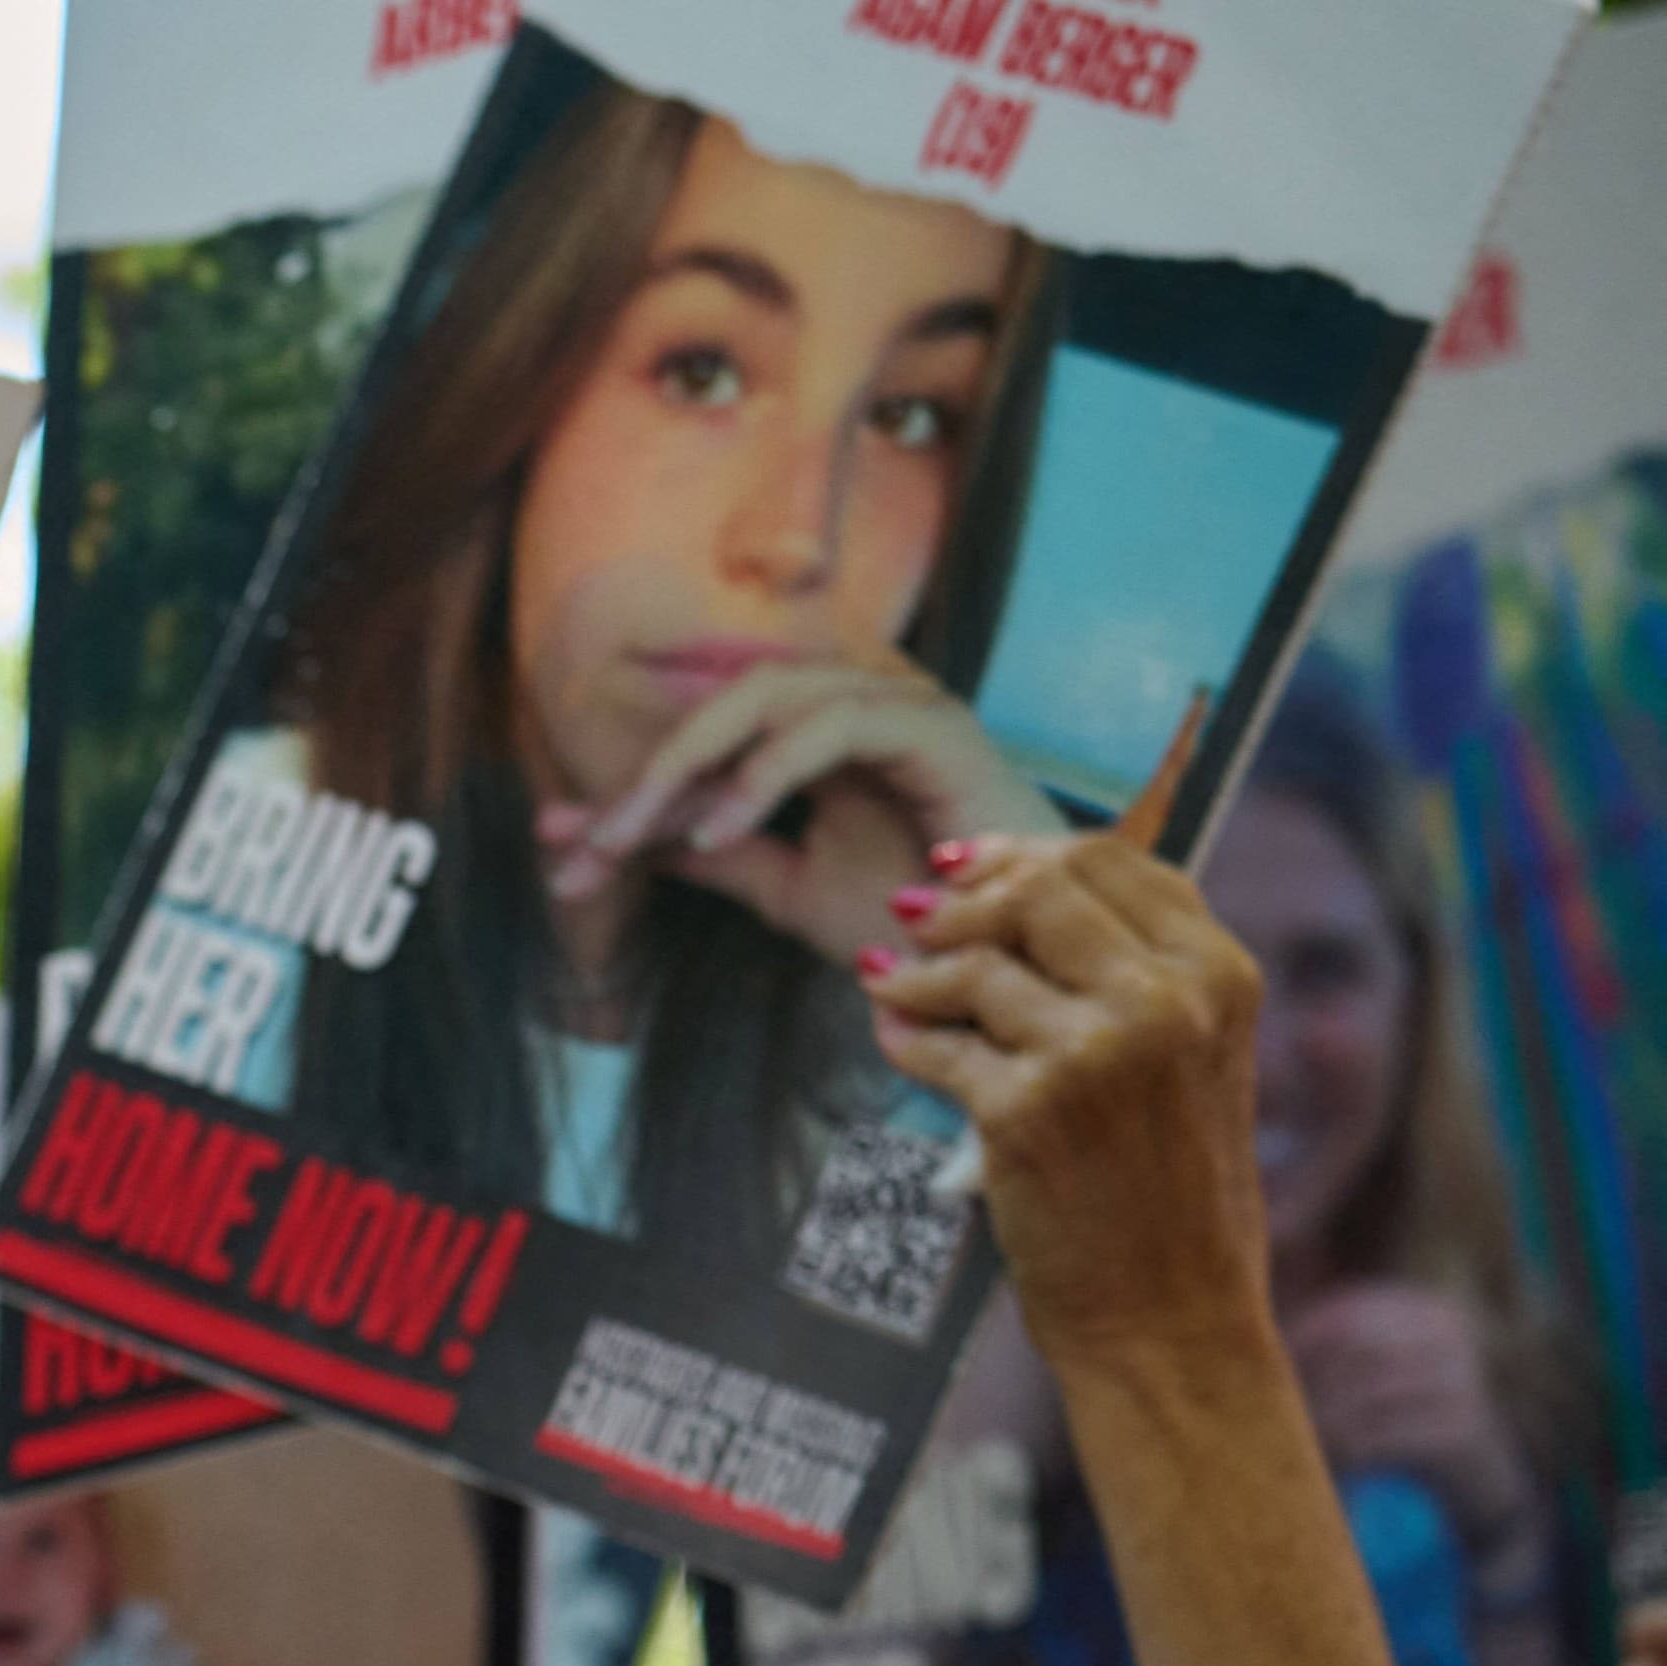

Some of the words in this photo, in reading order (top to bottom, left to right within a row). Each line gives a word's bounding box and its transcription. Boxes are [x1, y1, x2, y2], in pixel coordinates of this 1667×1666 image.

[998, 0, 1199, 123] BERGER
[157, 773, 437, 971] BRING
[90, 914, 282, 1096] HER
[19, 1071, 282, 1285] HOME
[247, 1157, 530, 1375] NOW!
[550, 1364, 727, 1492] FAMILIES
[715, 1430, 866, 1538] FORUM
